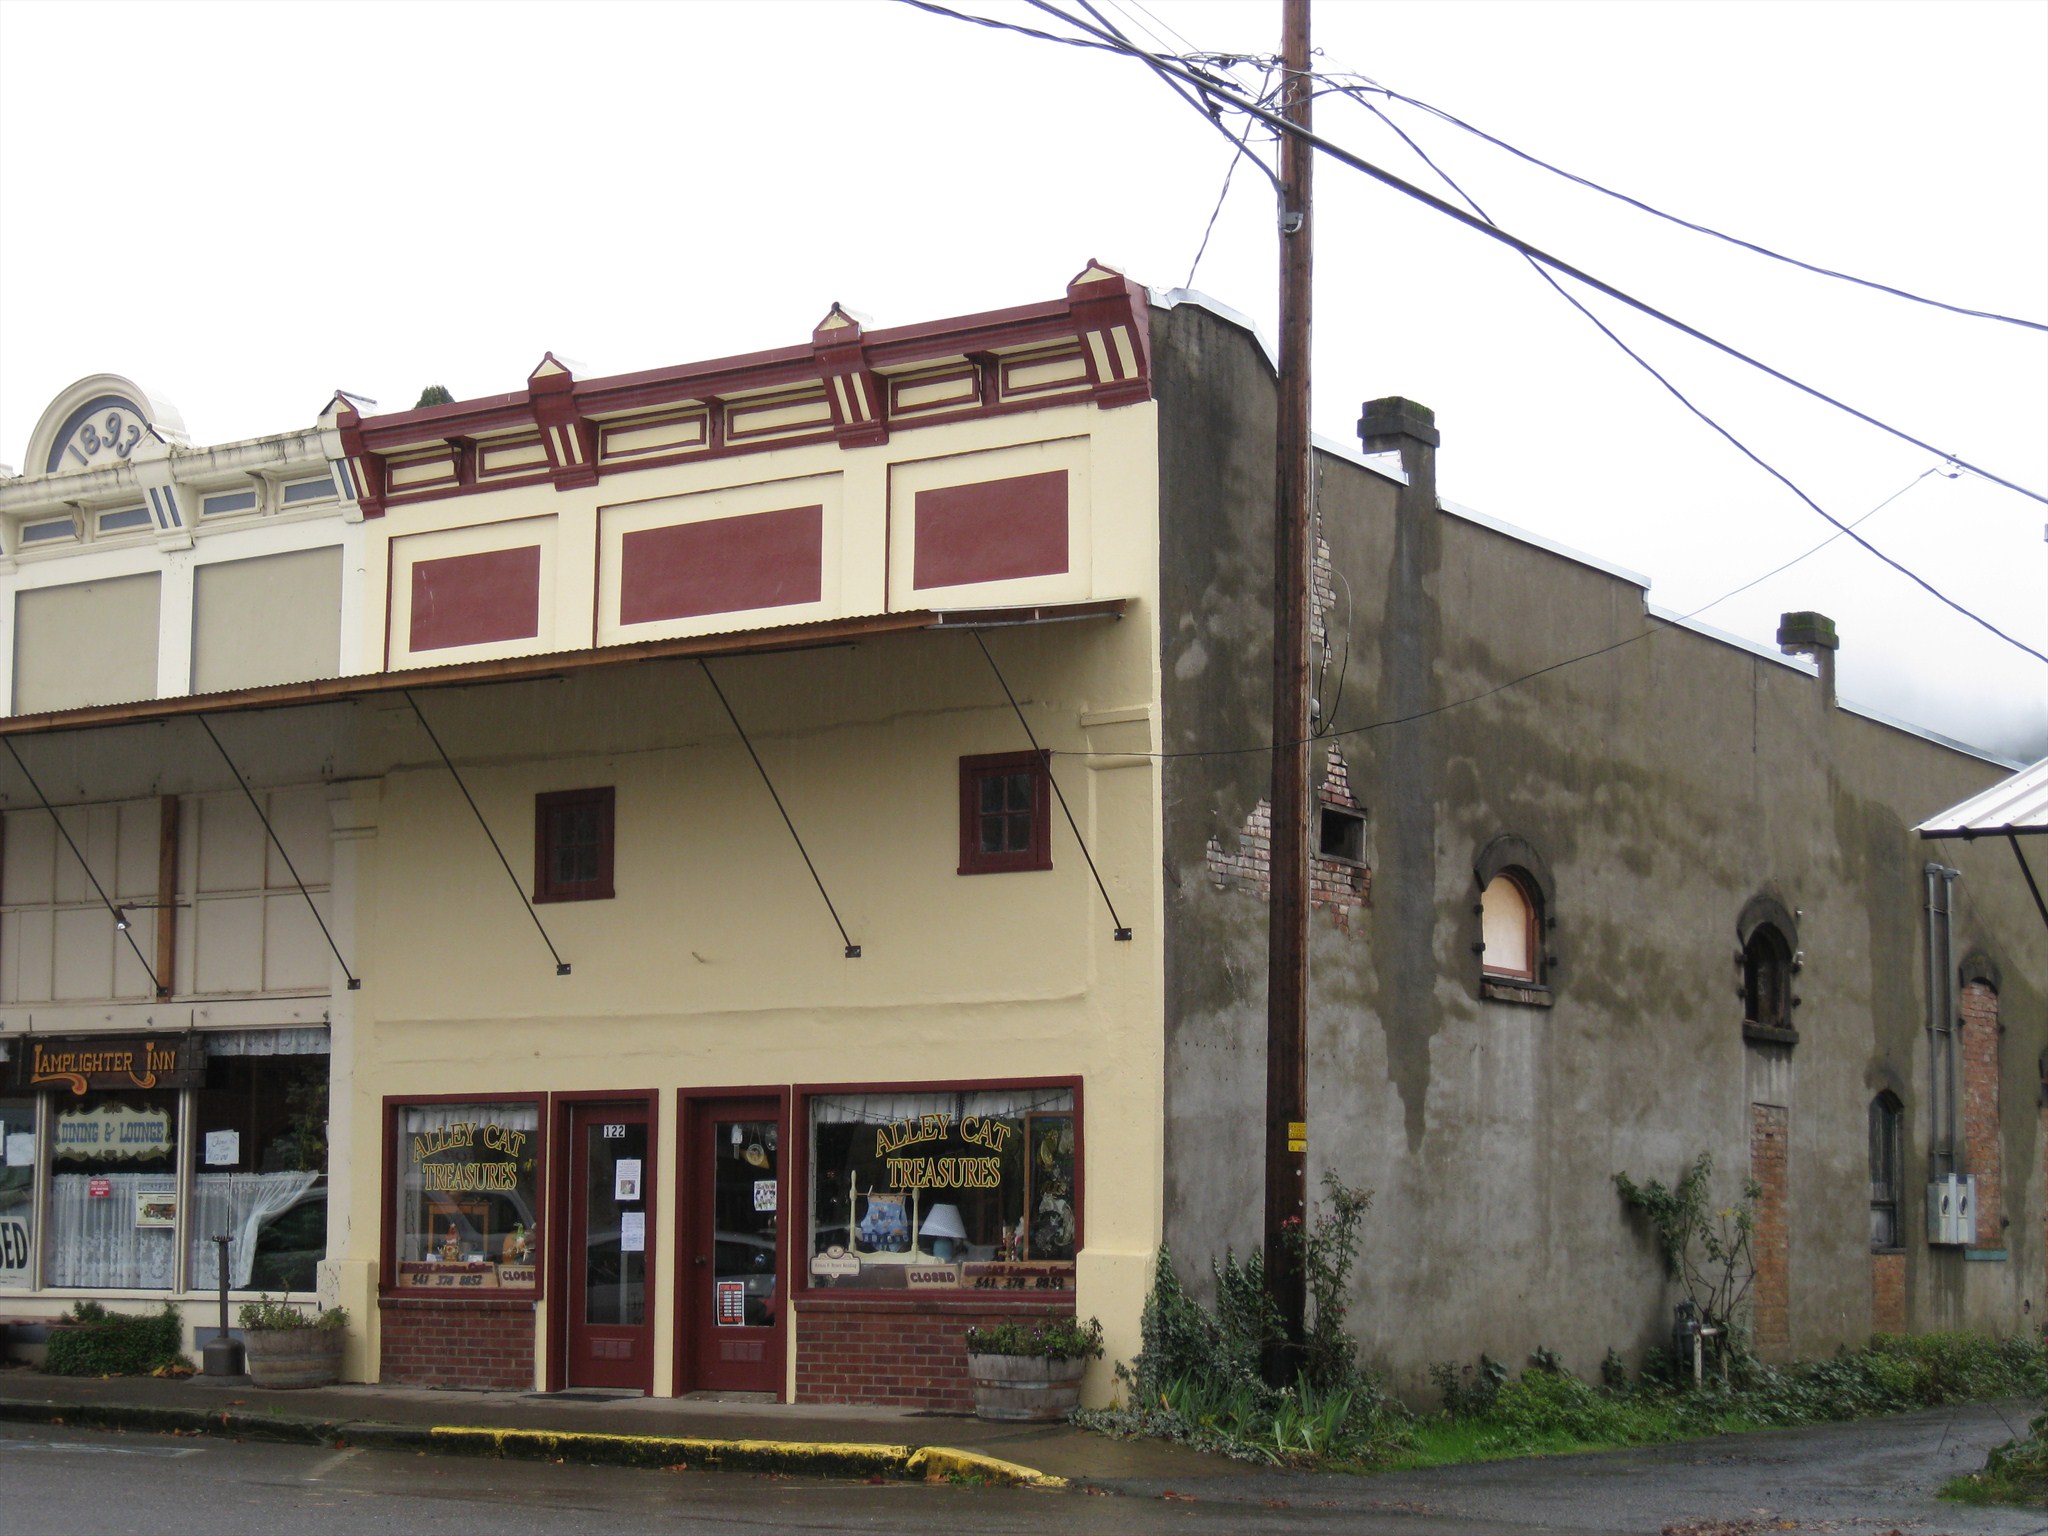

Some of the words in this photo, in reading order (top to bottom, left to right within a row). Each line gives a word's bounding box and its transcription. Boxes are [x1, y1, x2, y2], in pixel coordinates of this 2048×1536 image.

[67, 412, 140, 466] 1893
[30, 1043, 133, 1095] LAMPLIGHTER
[61, 1122, 99, 1143] DINING
[104, 1122, 115, 1140] &
[119, 1121, 164, 1143] LOUNGE
[413, 1122, 477, 1163] ALLEY
[483, 1124, 526, 1158] CAT
[605, 1125, 624, 1137] 122
[875, 1113, 952, 1158] ALLEY
[960, 1116, 1011, 1152] CAT
[423, 1162, 518, 1190] TREASURES
[886, 1157, 1000, 1188] TREASURES
[0, 1222, 28, 1269] ED
[502, 1271, 536, 1281] CLOSE
[910, 1271, 956, 1283] CLOSED
